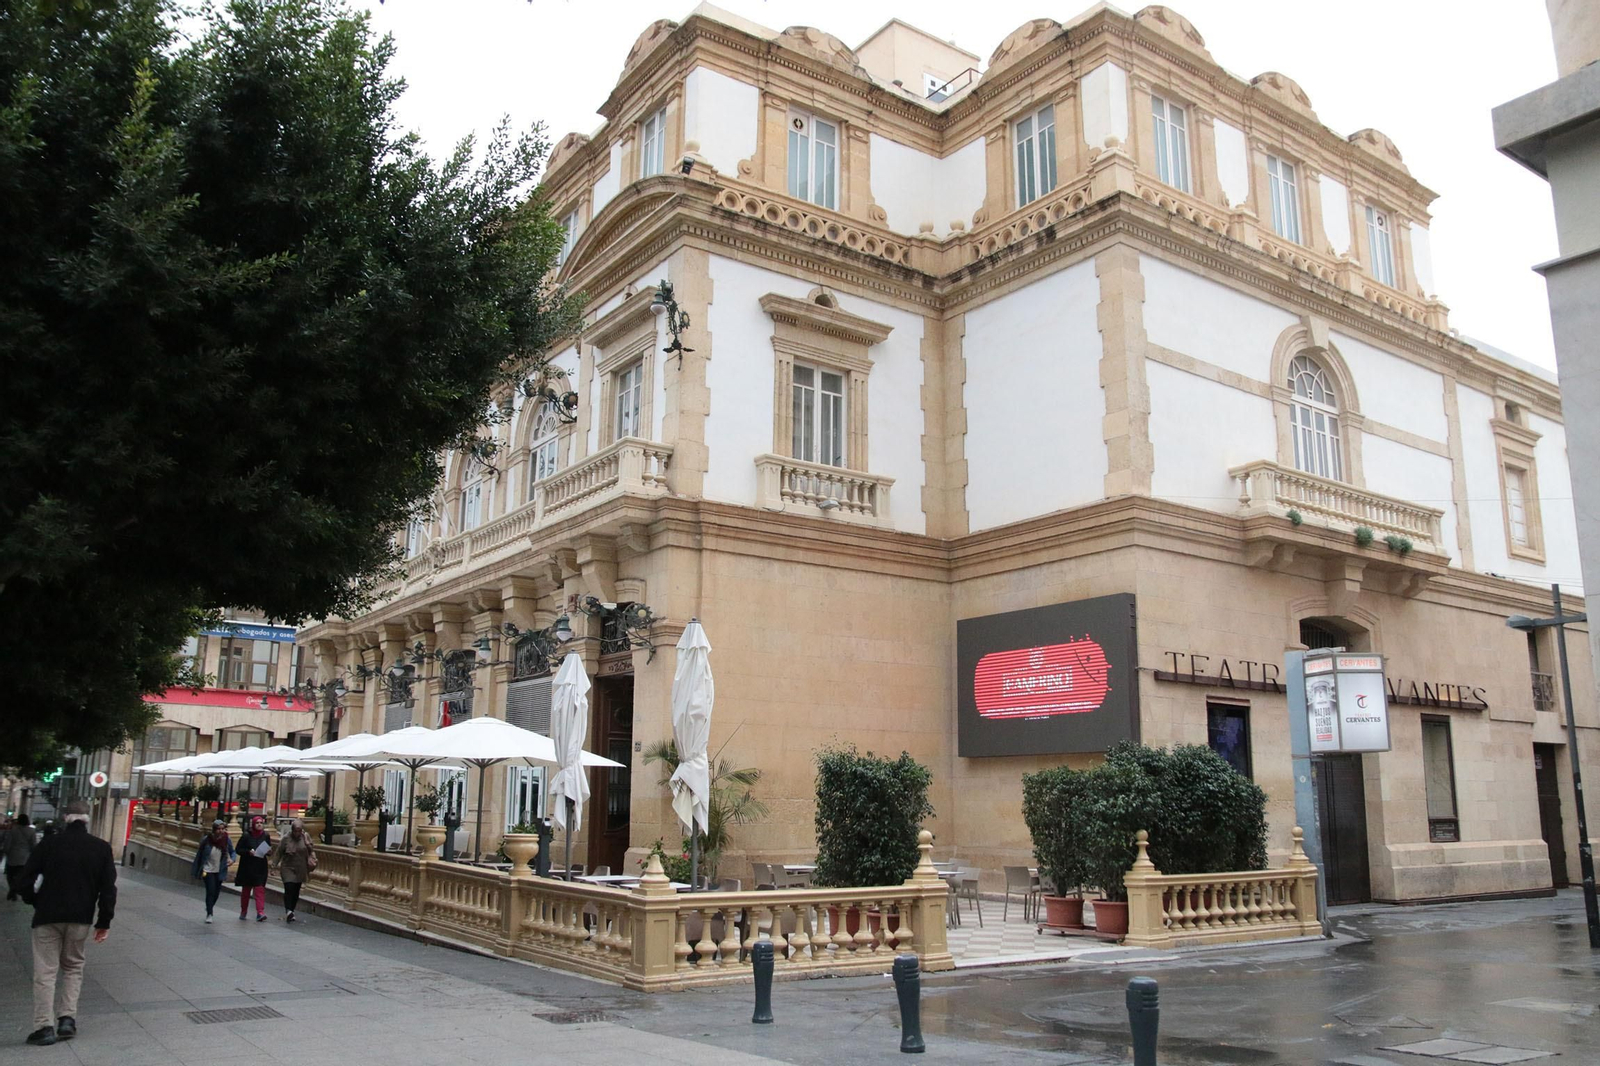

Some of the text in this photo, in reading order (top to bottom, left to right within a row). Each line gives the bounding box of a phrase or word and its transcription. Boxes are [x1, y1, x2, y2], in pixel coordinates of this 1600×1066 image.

[1339, 658, 1378, 667] CERVANTES
[1165, 652, 1489, 709] TEATR VANTES
